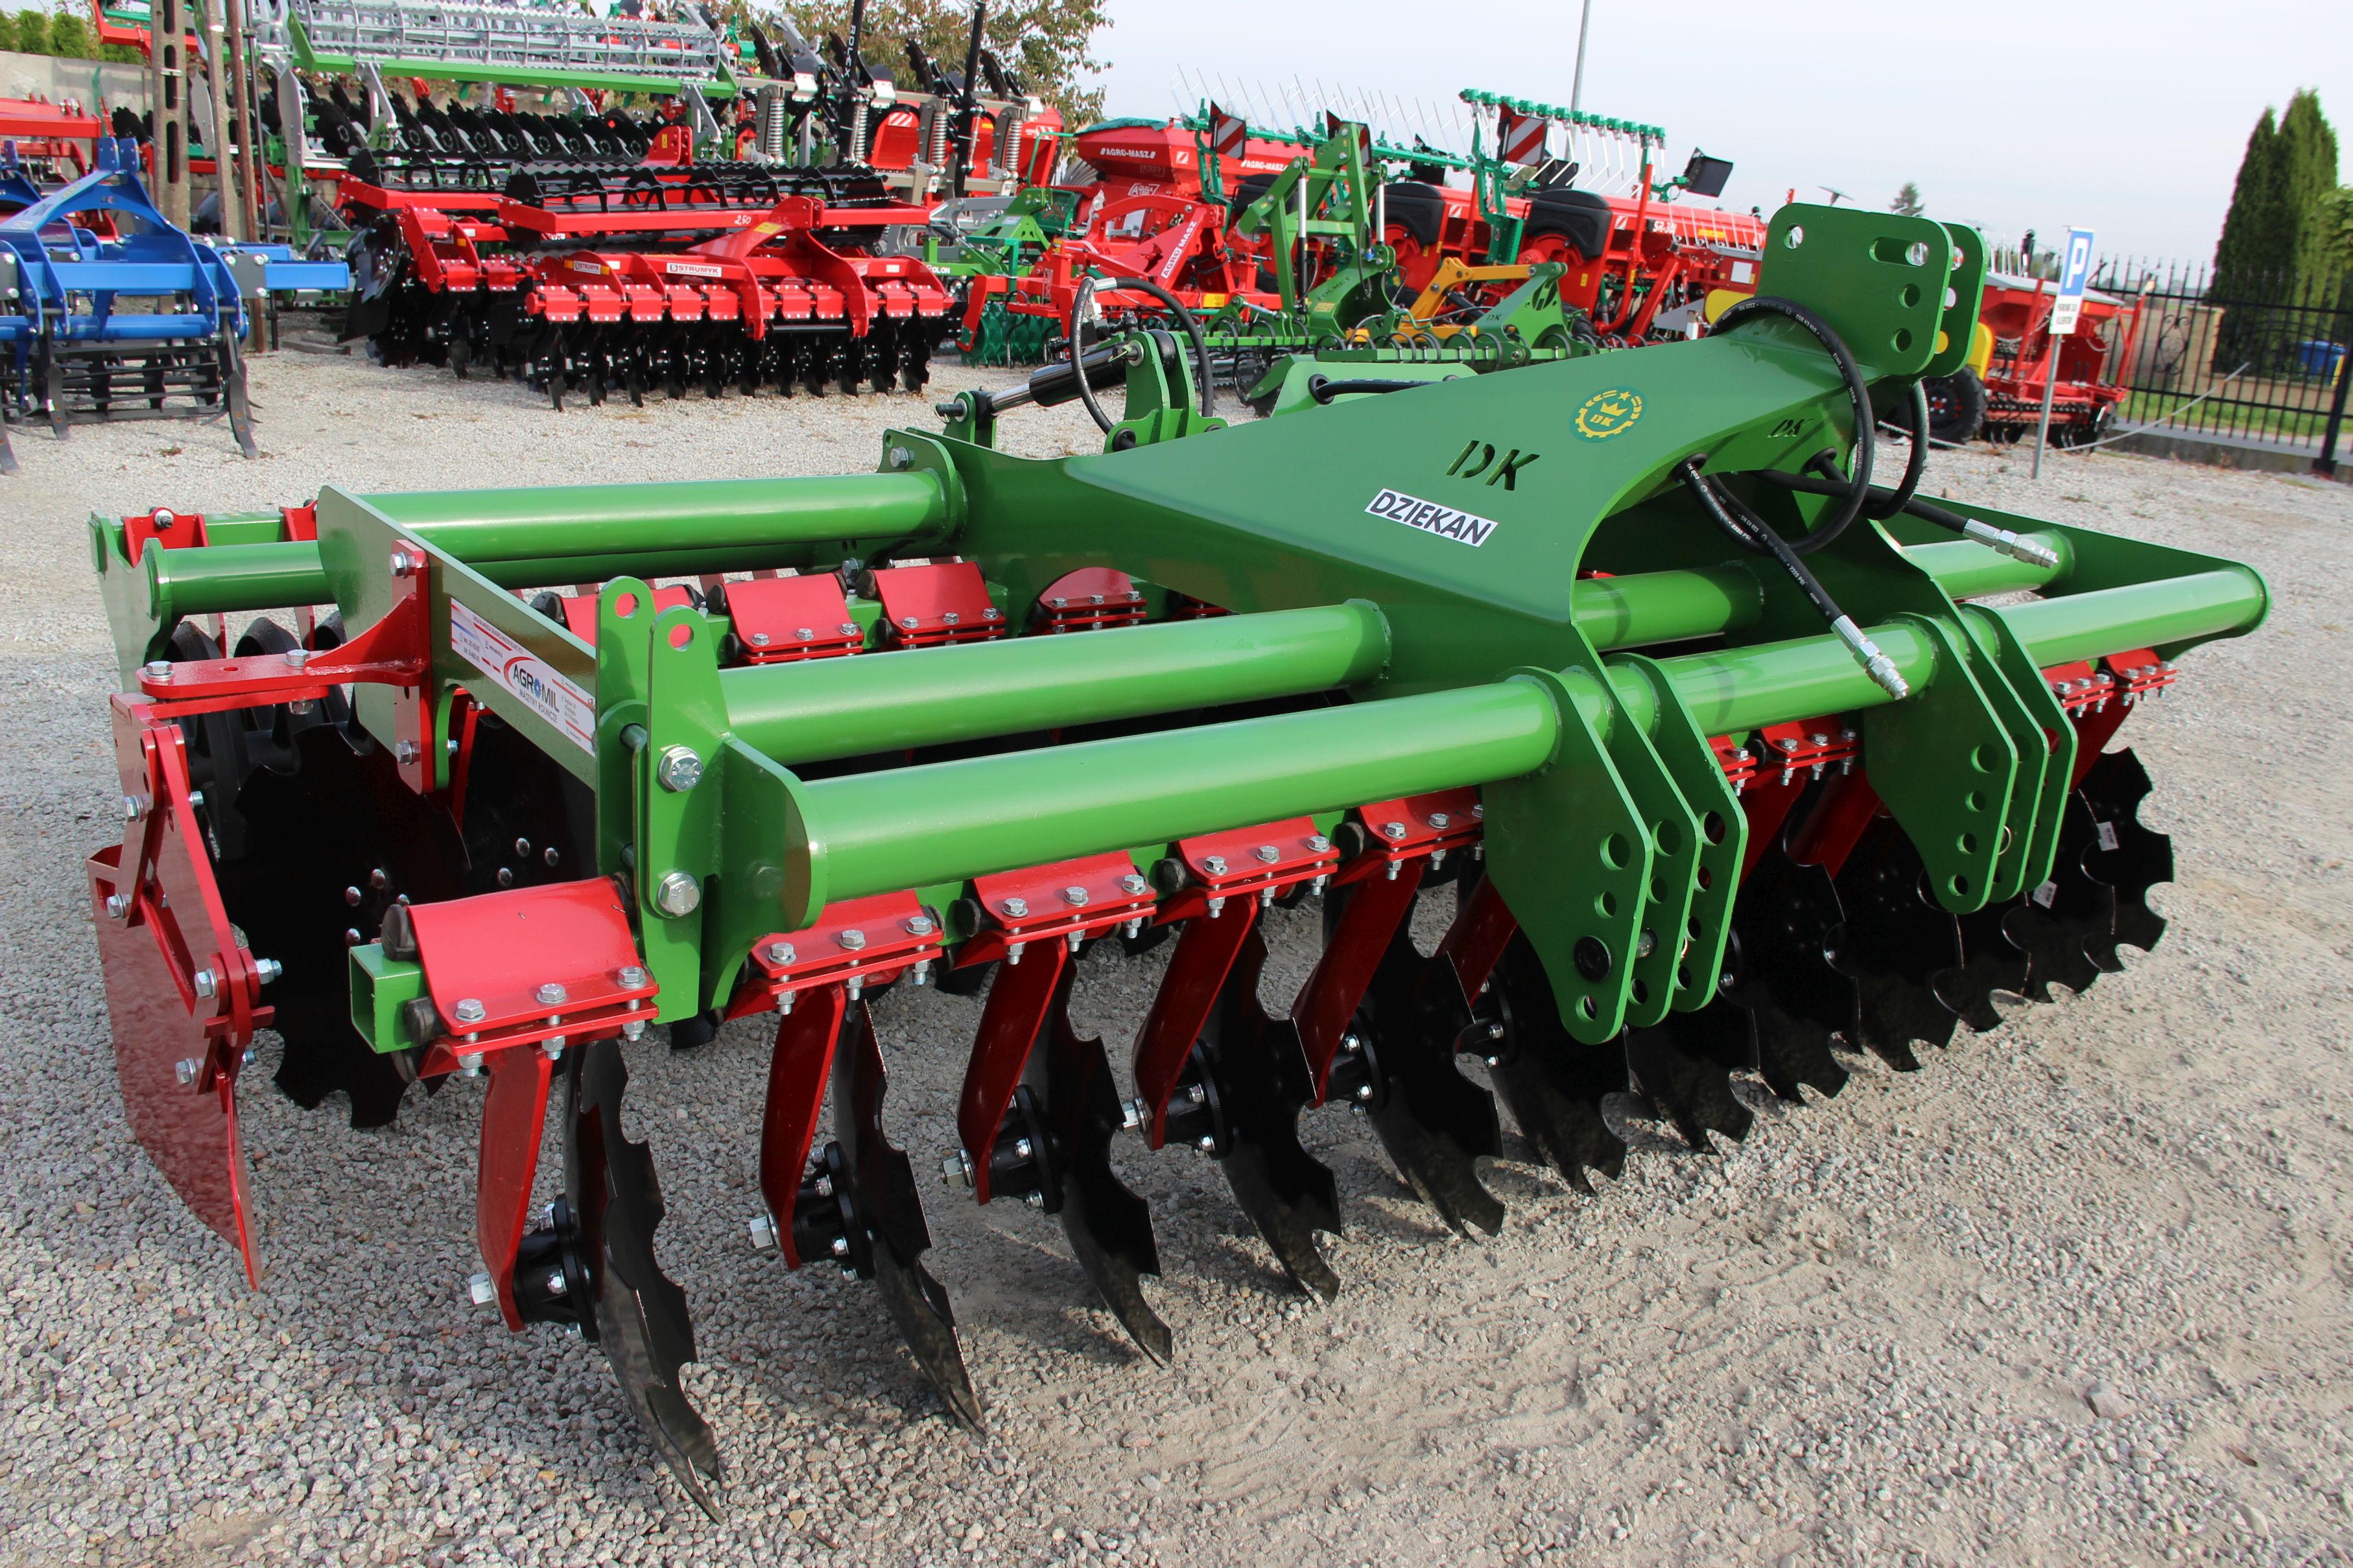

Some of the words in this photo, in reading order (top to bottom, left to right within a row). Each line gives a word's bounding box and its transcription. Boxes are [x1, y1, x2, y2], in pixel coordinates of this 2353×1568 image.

[845, 25, 856, 77] ROLEX
[1106, 148, 1149, 158] AGRO-MASZ
[1246, 160, 1284, 171] AGRO-MASZ
[1163, 250, 1181, 275] AGRO
[1178, 221, 1197, 247] MASZ
[679, 265, 718, 274] STRUMYK
[2065, 237, 2089, 289] P
[1589, 414, 1615, 427] DK
[1767, 419, 1813, 438] DK
[1446, 440, 1540, 491] DK
[1369, 492, 1491, 544] DZIEKAN
[1789, 566, 1799, 578] 2320
